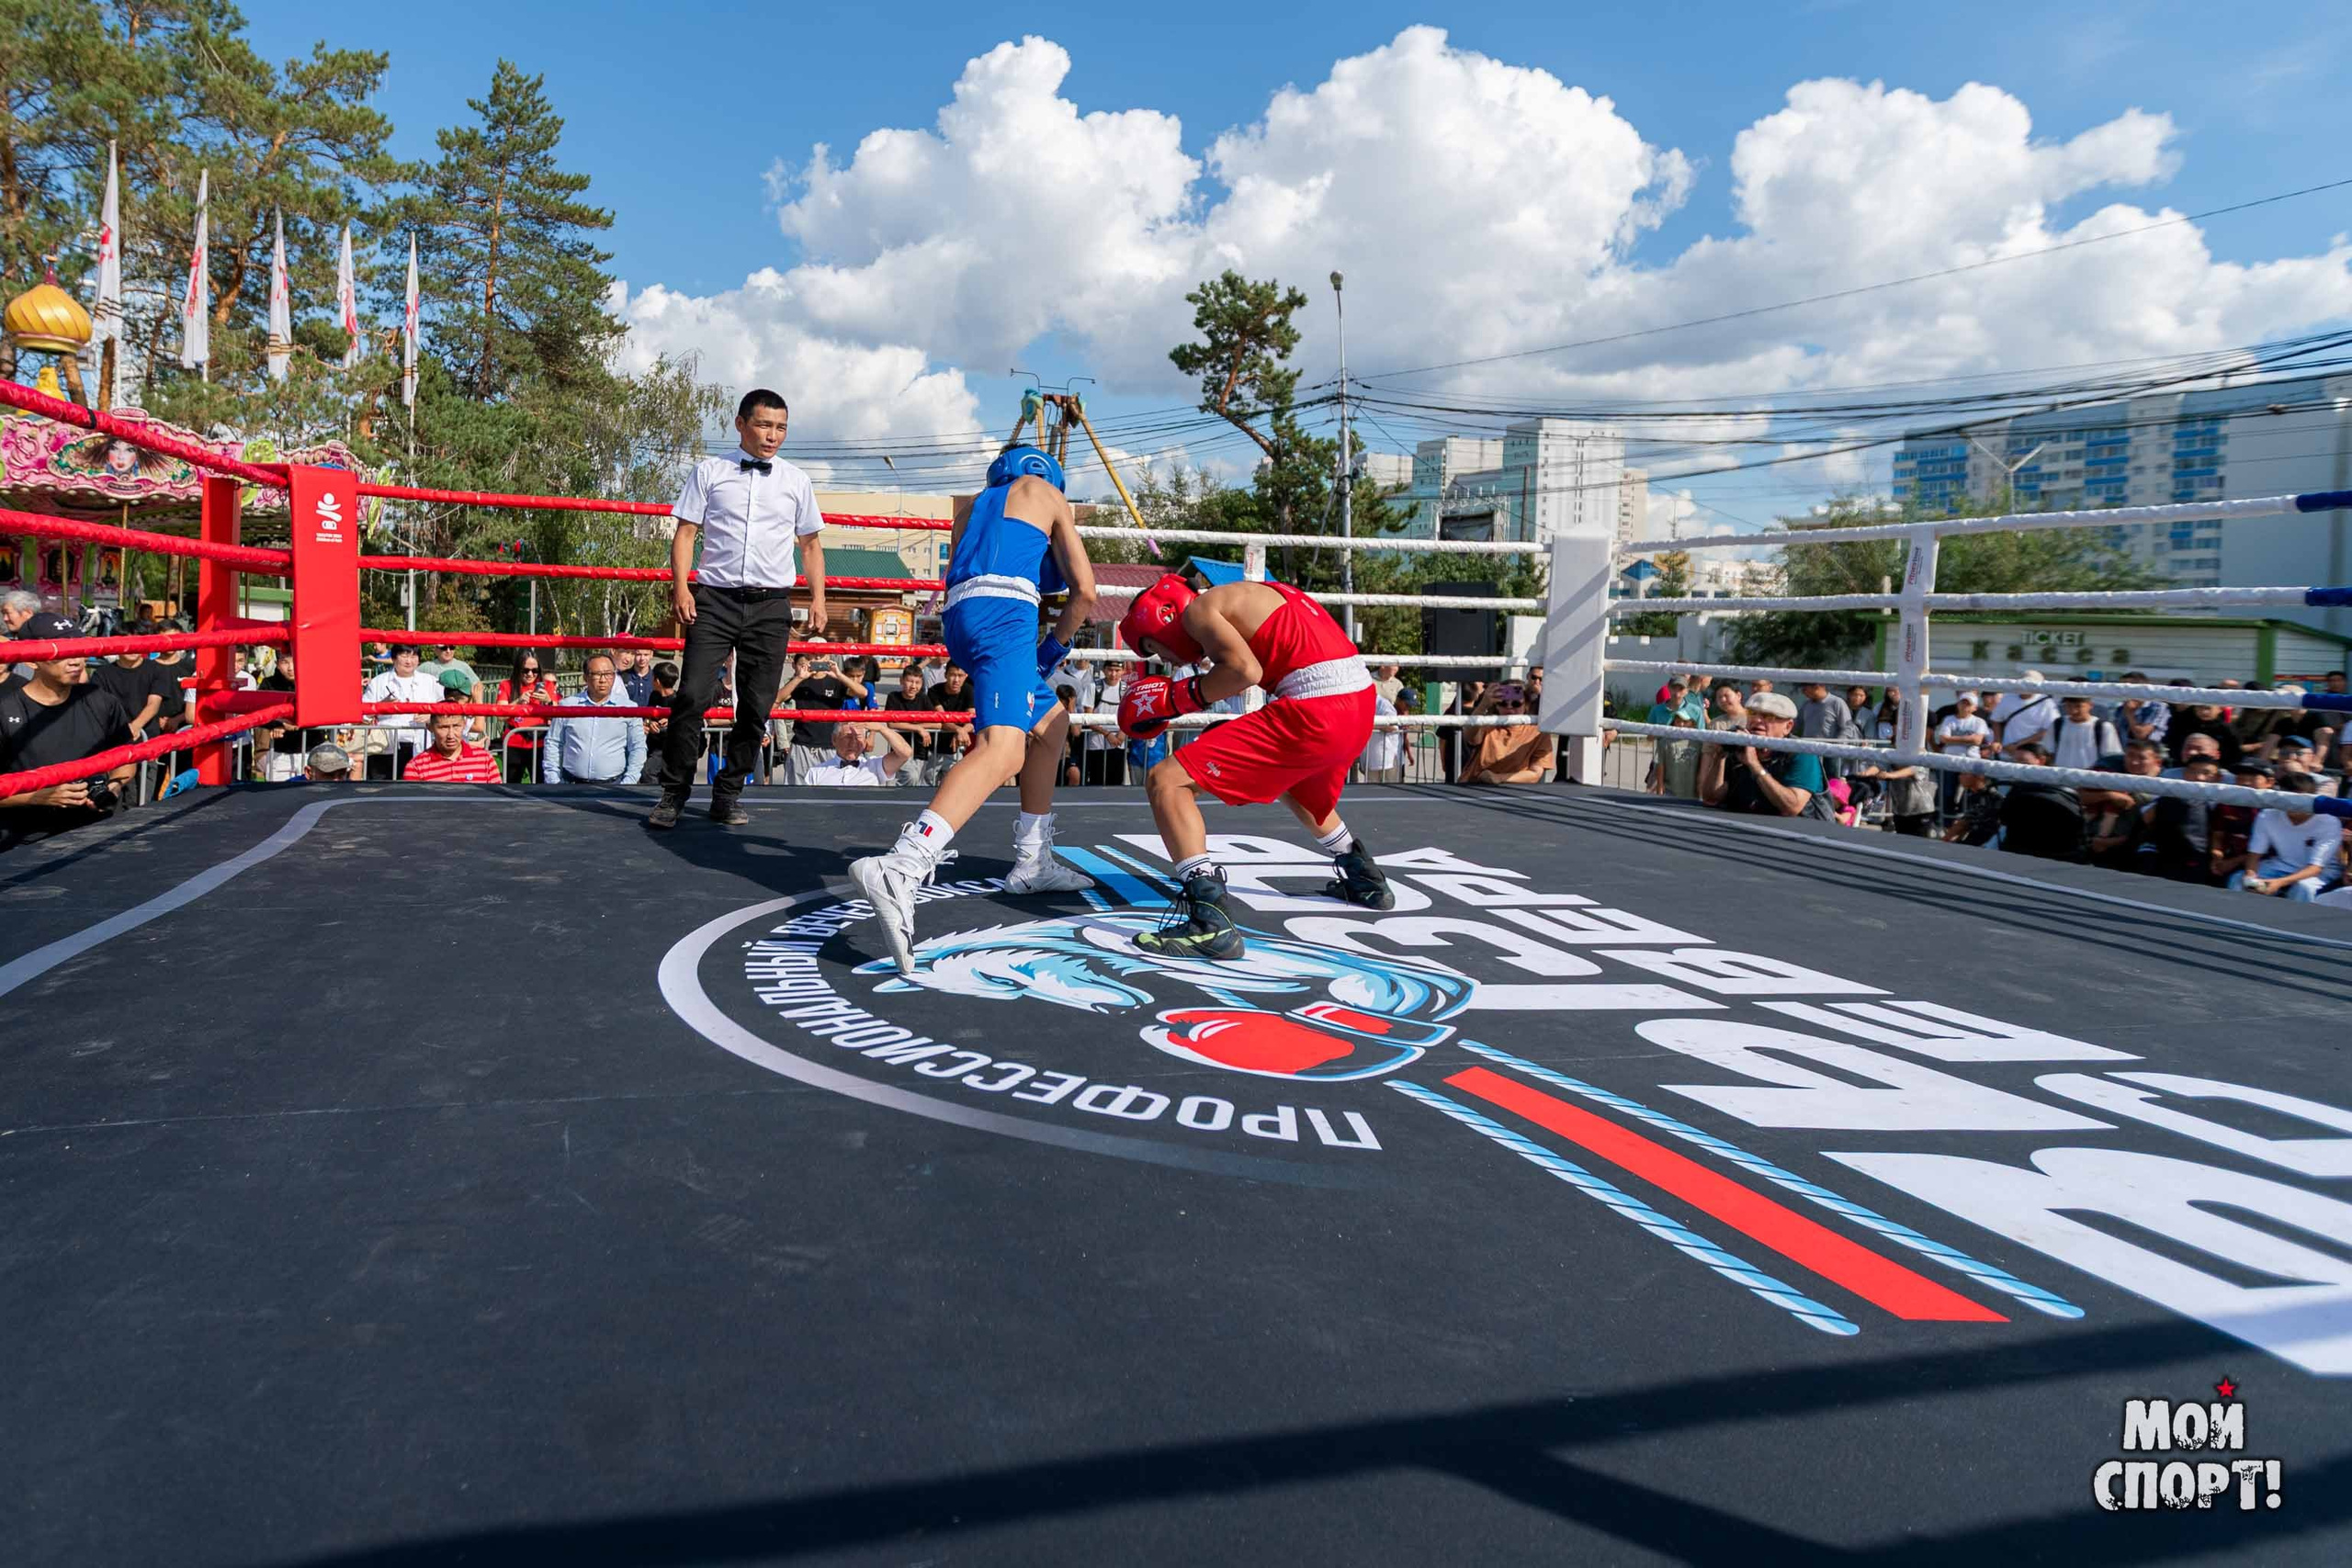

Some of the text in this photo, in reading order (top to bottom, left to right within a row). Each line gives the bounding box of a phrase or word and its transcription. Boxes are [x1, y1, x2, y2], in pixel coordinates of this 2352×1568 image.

[2021, 629, 2084, 646] TICKET
[770, 899, 876, 937] ВЕЧЕР
[741, 939, 1383, 1151] ПРОФЕССИОНАЛЬНЫЙ
